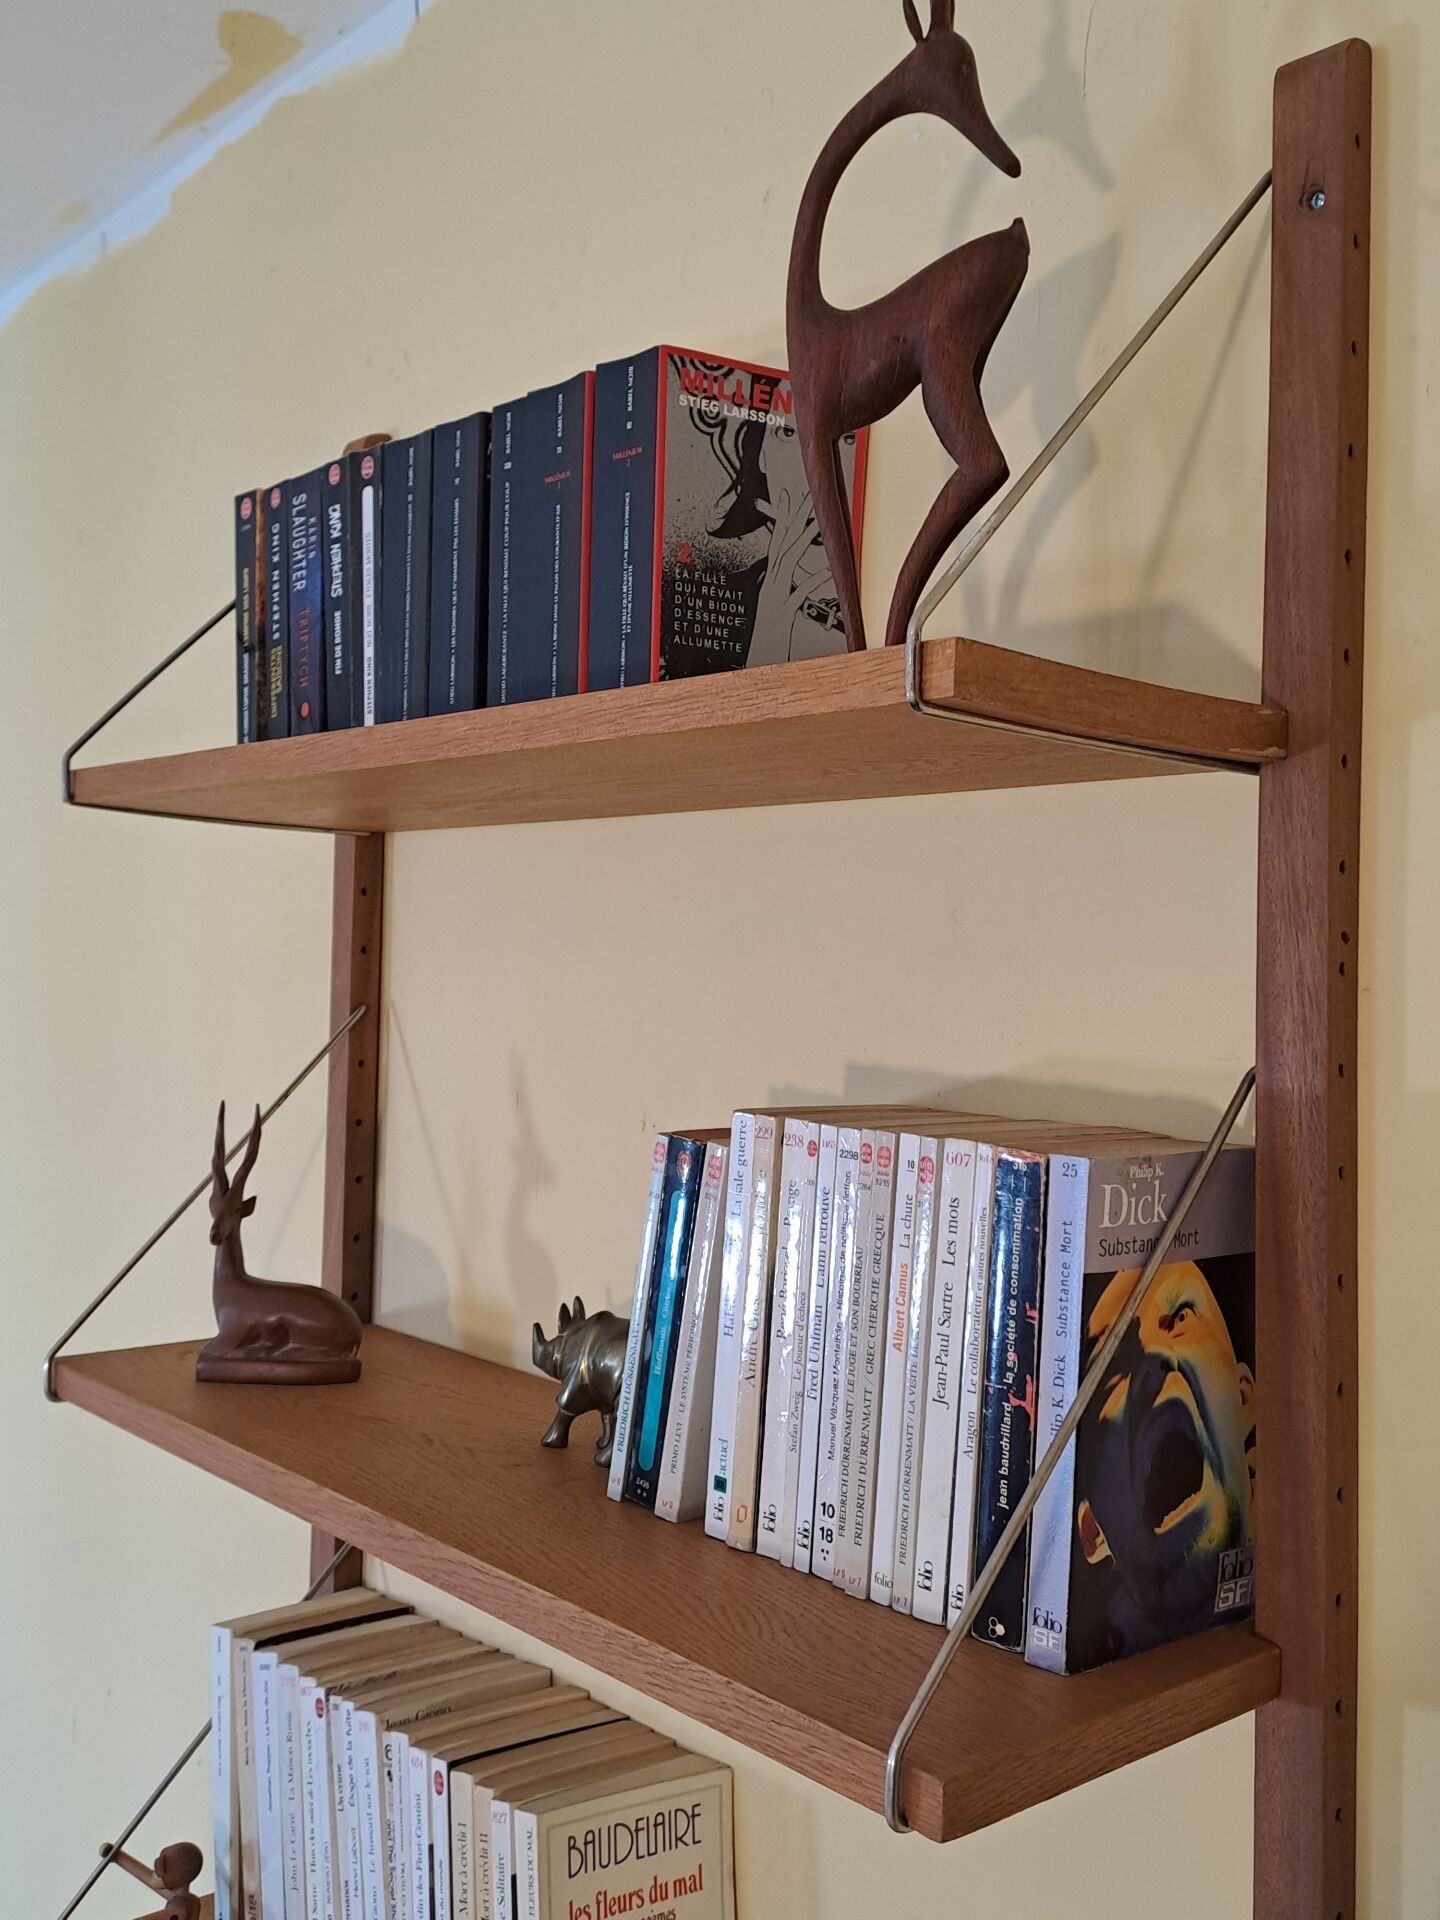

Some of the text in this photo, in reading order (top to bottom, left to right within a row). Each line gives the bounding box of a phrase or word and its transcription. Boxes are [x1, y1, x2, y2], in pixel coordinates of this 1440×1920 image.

[678, 394, 786, 427] STIEG LARSSON
[271, 522, 280, 563] KING
[291, 493, 308, 592] SLAUGHTER
[308, 516, 317, 559] KARIN
[328, 503, 343, 598] STEPHEN KING
[676, 540, 691, 564] 2
[675, 568, 727, 585] LA FILLE
[675, 582, 743, 601] QUI RÊVAIT
[271, 569, 281, 641] STEPHEN
[674, 608, 745, 628] D'ESSENCE
[675, 595, 745, 614] D'UN BIDON
[298, 608, 311, 688] TRIPTYCH
[673, 634, 743, 653] ALLUMETTE
[674, 621, 730, 638] ET D'UNE
[755, 1124, 772, 1140] 229
[783, 1132, 804, 1149] 238
[731, 1118, 748, 1218] La sale guerre
[838, 1149, 860, 1162] 2298
[907, 1159, 915, 1170] 10
[946, 1152, 973, 1168] 607
[1012, 1160, 1028, 1172] 316
[1061, 1162, 1079, 1179] 25
[1129, 1163, 1165, 1182] Philip K.
[817, 1186, 832, 1245] retrouvé
[837, 1170, 852, 1263] de fiction
[899, 1193, 914, 1248] La chute
[1098, 1179, 1169, 1229] Dick
[941, 1196, 960, 1266] Les mots
[1173, 1227, 1200, 1249] Mort
[1002, 1197, 1023, 1384] la société de consommation
[1056, 1219, 1072, 1338] Substance Mort
[892, 1262, 908, 1352] Albert Camus
[966, 1206, 988, 1395] Le collaborateur et autres nouvelles
[792, 1290, 807, 1381] Le Joueur d'échecs
[804, 1303, 823, 1401] Fred Uhlman
[931, 1281, 954, 1410] Jean-Paul Sartre
[837, 1245, 863, 1538] FRIEDRICH DÜRRENMATT LE JUGE ET SON BOURREAU
[853, 1213, 885, 1547] FRIEDRICH DÜRRENMATT GREC CHERCHE GRECQUE
[1051, 1354, 1066, 1410] K. Dick
[614, 1396, 630, 1454] FRIEDRICH
[677, 1400, 687, 1414] LE
[787, 1390, 802, 1454] Stefan Zweig
[827, 1376, 839, 1461] Manuel Vázquez
[668, 1421, 683, 1476] PRIMO LEVI
[962, 1410, 977, 1460] Aragon
[997, 1400, 1013, 1510] jean baudrillard
[712, 1437, 729, 1523] folio actuel
[898, 1360, 919, 1566] FRIEDRICH DÜRRENMATT LA VISITE
[761, 1502, 777, 1534] folio
[820, 1502, 836, 1519] 10
[796, 1519, 811, 1551] folio
[818, 1526, 834, 1544] 18
[874, 1571, 893, 1588] folio
[917, 1560, 934, 1593] folio
[1220, 1550, 1254, 1585] folio
[951, 1584, 965, 1611] folio
[1218, 1579, 1250, 1609] SF
[1032, 1607, 1063, 1634] folio
[1034, 1628, 1060, 1650] SF
[345, 1708, 353, 1737] fuite
[345, 1740, 353, 1752] la
[346, 1754, 354, 1770] de
[336, 1763, 345, 1812] Un crime
[456, 1831, 468, 1868] crédit
[567, 1802, 703, 1880] BAUDELAIRE
[458, 1870, 469, 1879] à
[479, 1833, 489, 1896] à crédit II
[495, 1852, 506, 1908] Solitaire
[526, 1827, 536, 1917] FLEURS DU MAL
[458, 1881, 469, 1916] Mort
[568, 1863, 704, 1920] les fleurs du mal
